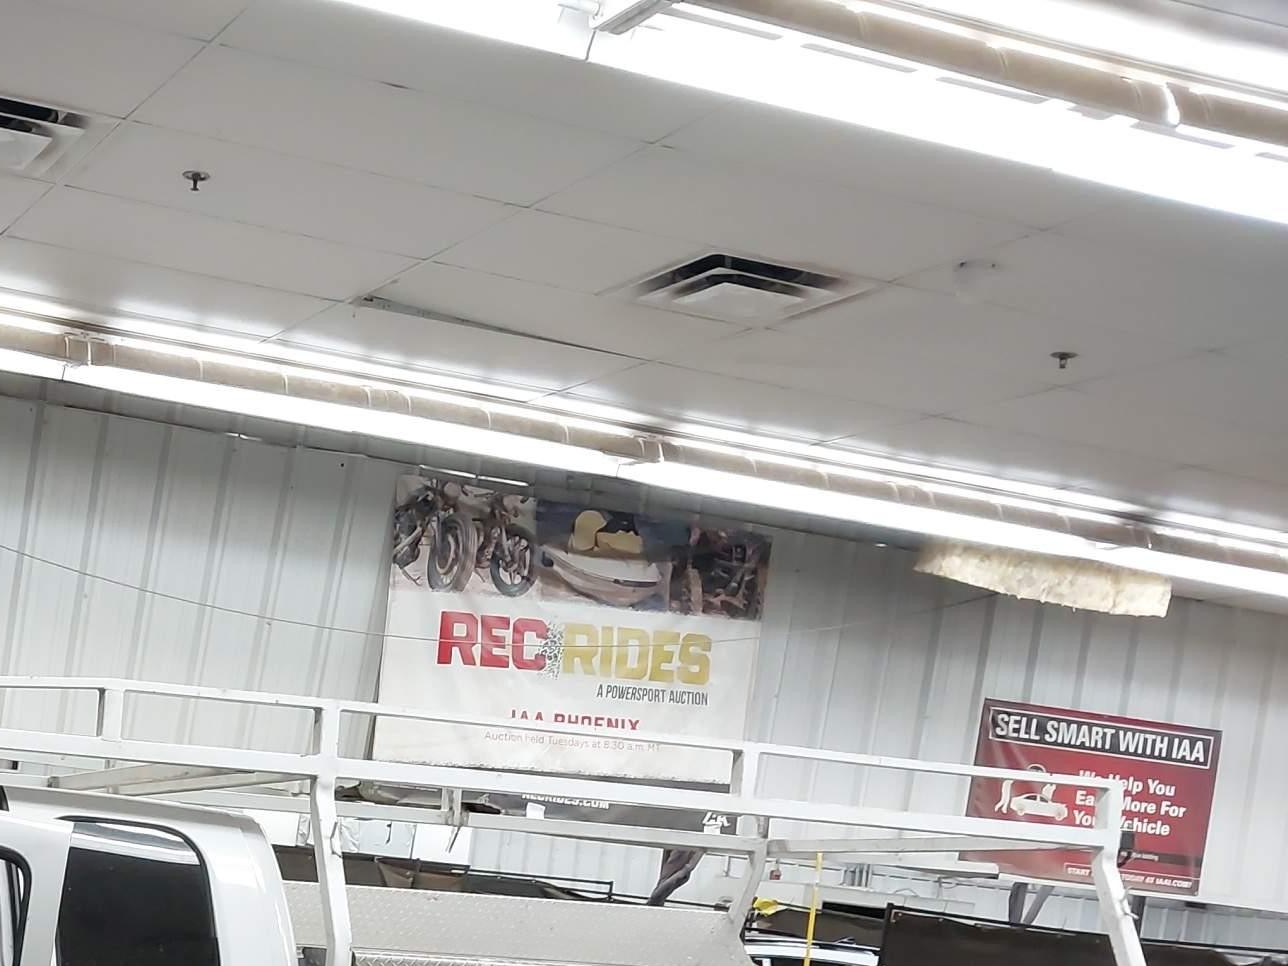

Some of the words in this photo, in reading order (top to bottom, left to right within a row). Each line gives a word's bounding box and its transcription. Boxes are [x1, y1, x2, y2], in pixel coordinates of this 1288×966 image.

[437, 611, 550, 671] REC
[562, 623, 712, 686] RIDES
[596, 684, 604, 698] A
[605, 684, 667, 703] POWERSPORT
[668, 690, 709, 706] AUCTION
[484, 732, 523, 743] Auction
[548, 736, 590, 749] Tuesdays
[603, 740, 624, 750] 830
[995, 712, 1040, 741] SELL
[1045, 720, 1115, 750] SMART
[1118, 730, 1166, 758] WITH
[1171, 738, 1205, 763] IAA
[1147, 778, 1176, 797] You
[1075, 789, 1095, 806] Ea
[1160, 800, 1187, 818] For
[1073, 809, 1096, 826] Yo
